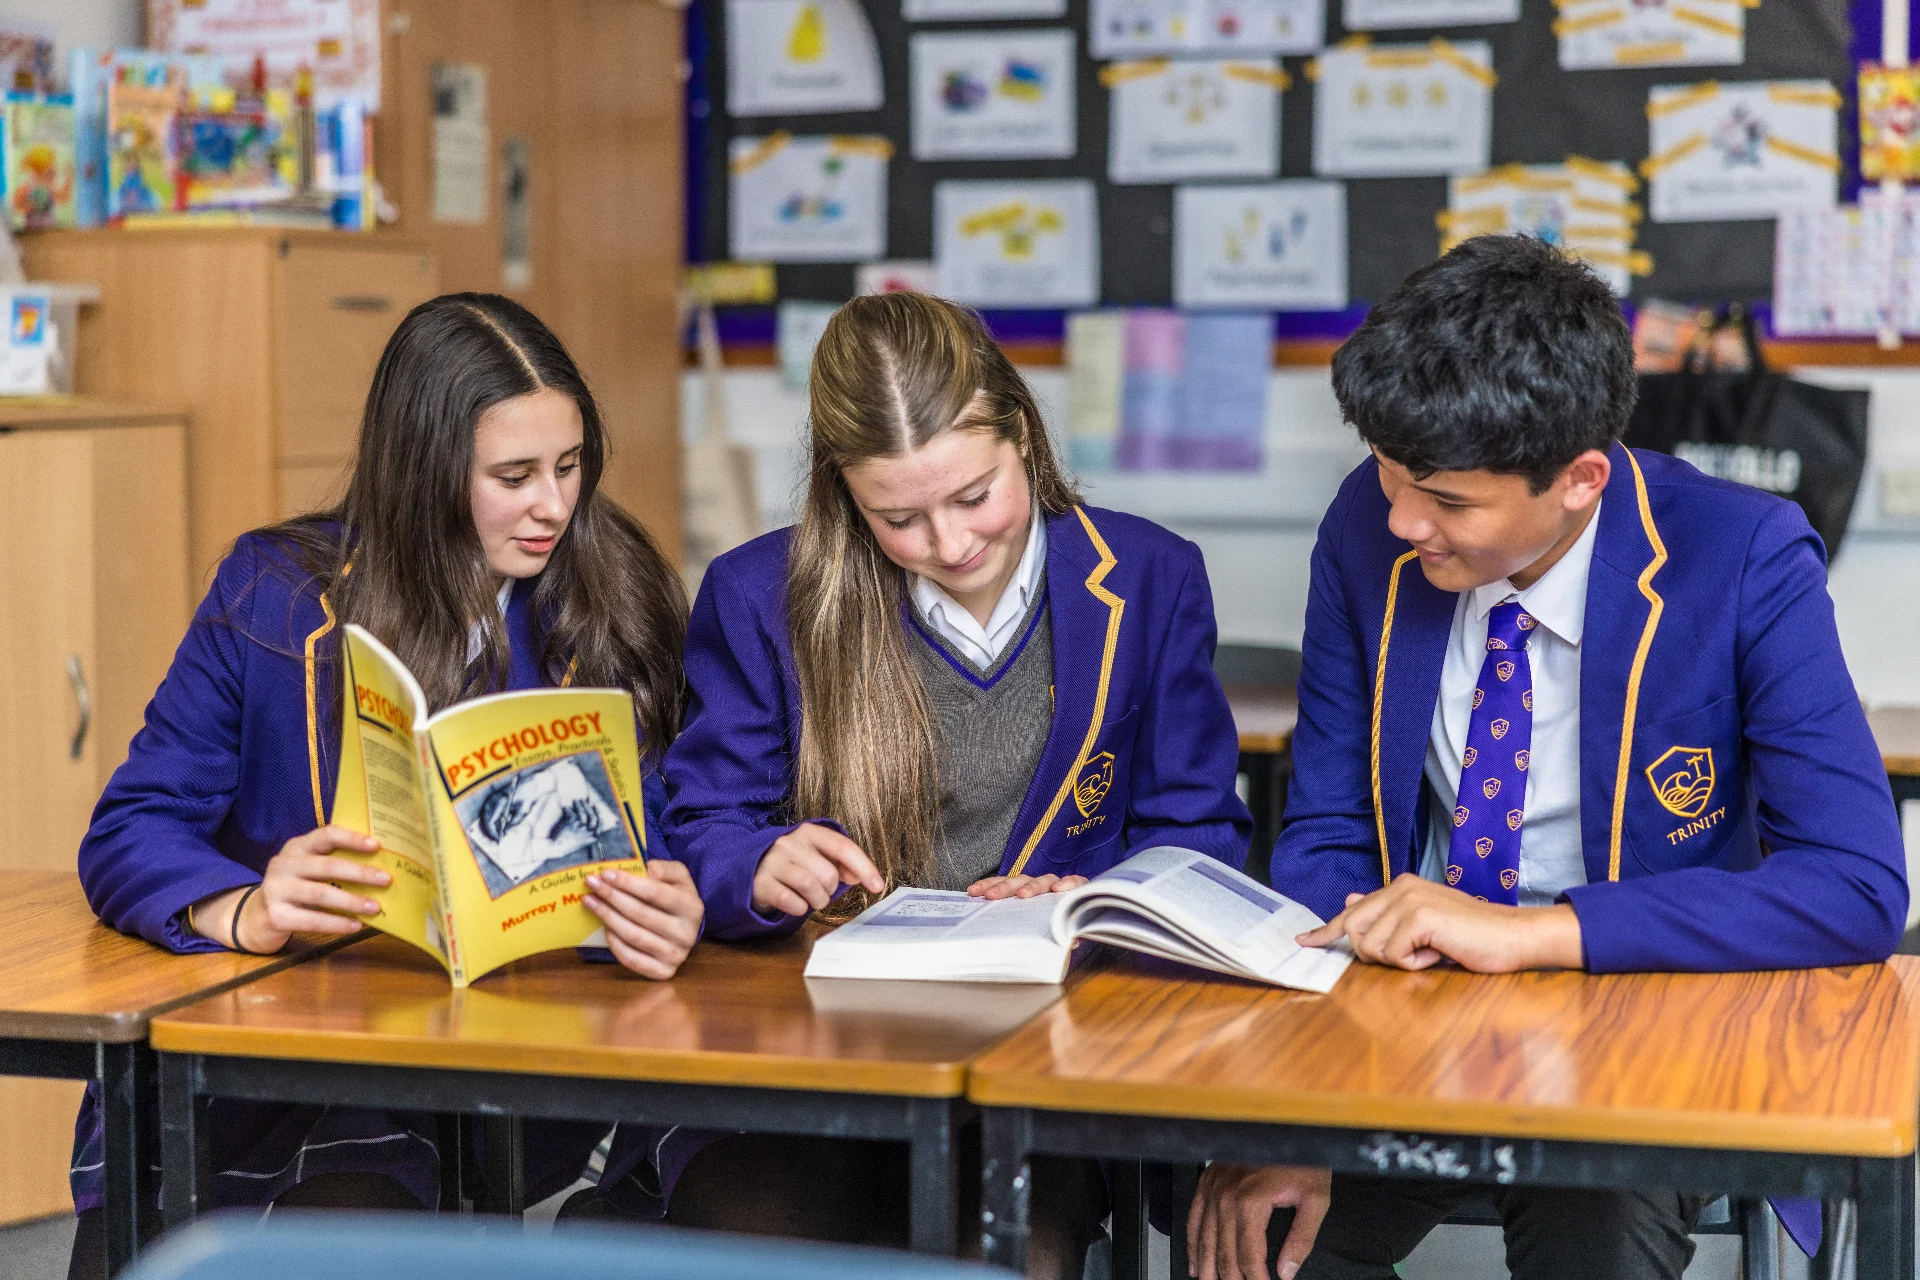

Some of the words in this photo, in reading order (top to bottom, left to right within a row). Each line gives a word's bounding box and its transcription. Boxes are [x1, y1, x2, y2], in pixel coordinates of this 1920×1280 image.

[447, 711, 603, 788] PSYCHOLOGY
[557, 735, 612, 753] Practicals
[1066, 815, 1106, 838] TRINITY
[1666, 806, 1726, 845] TRINITY
[529, 884, 538, 895] A
[541, 873, 576, 890] Guide
[501, 901, 557, 932] Murray
